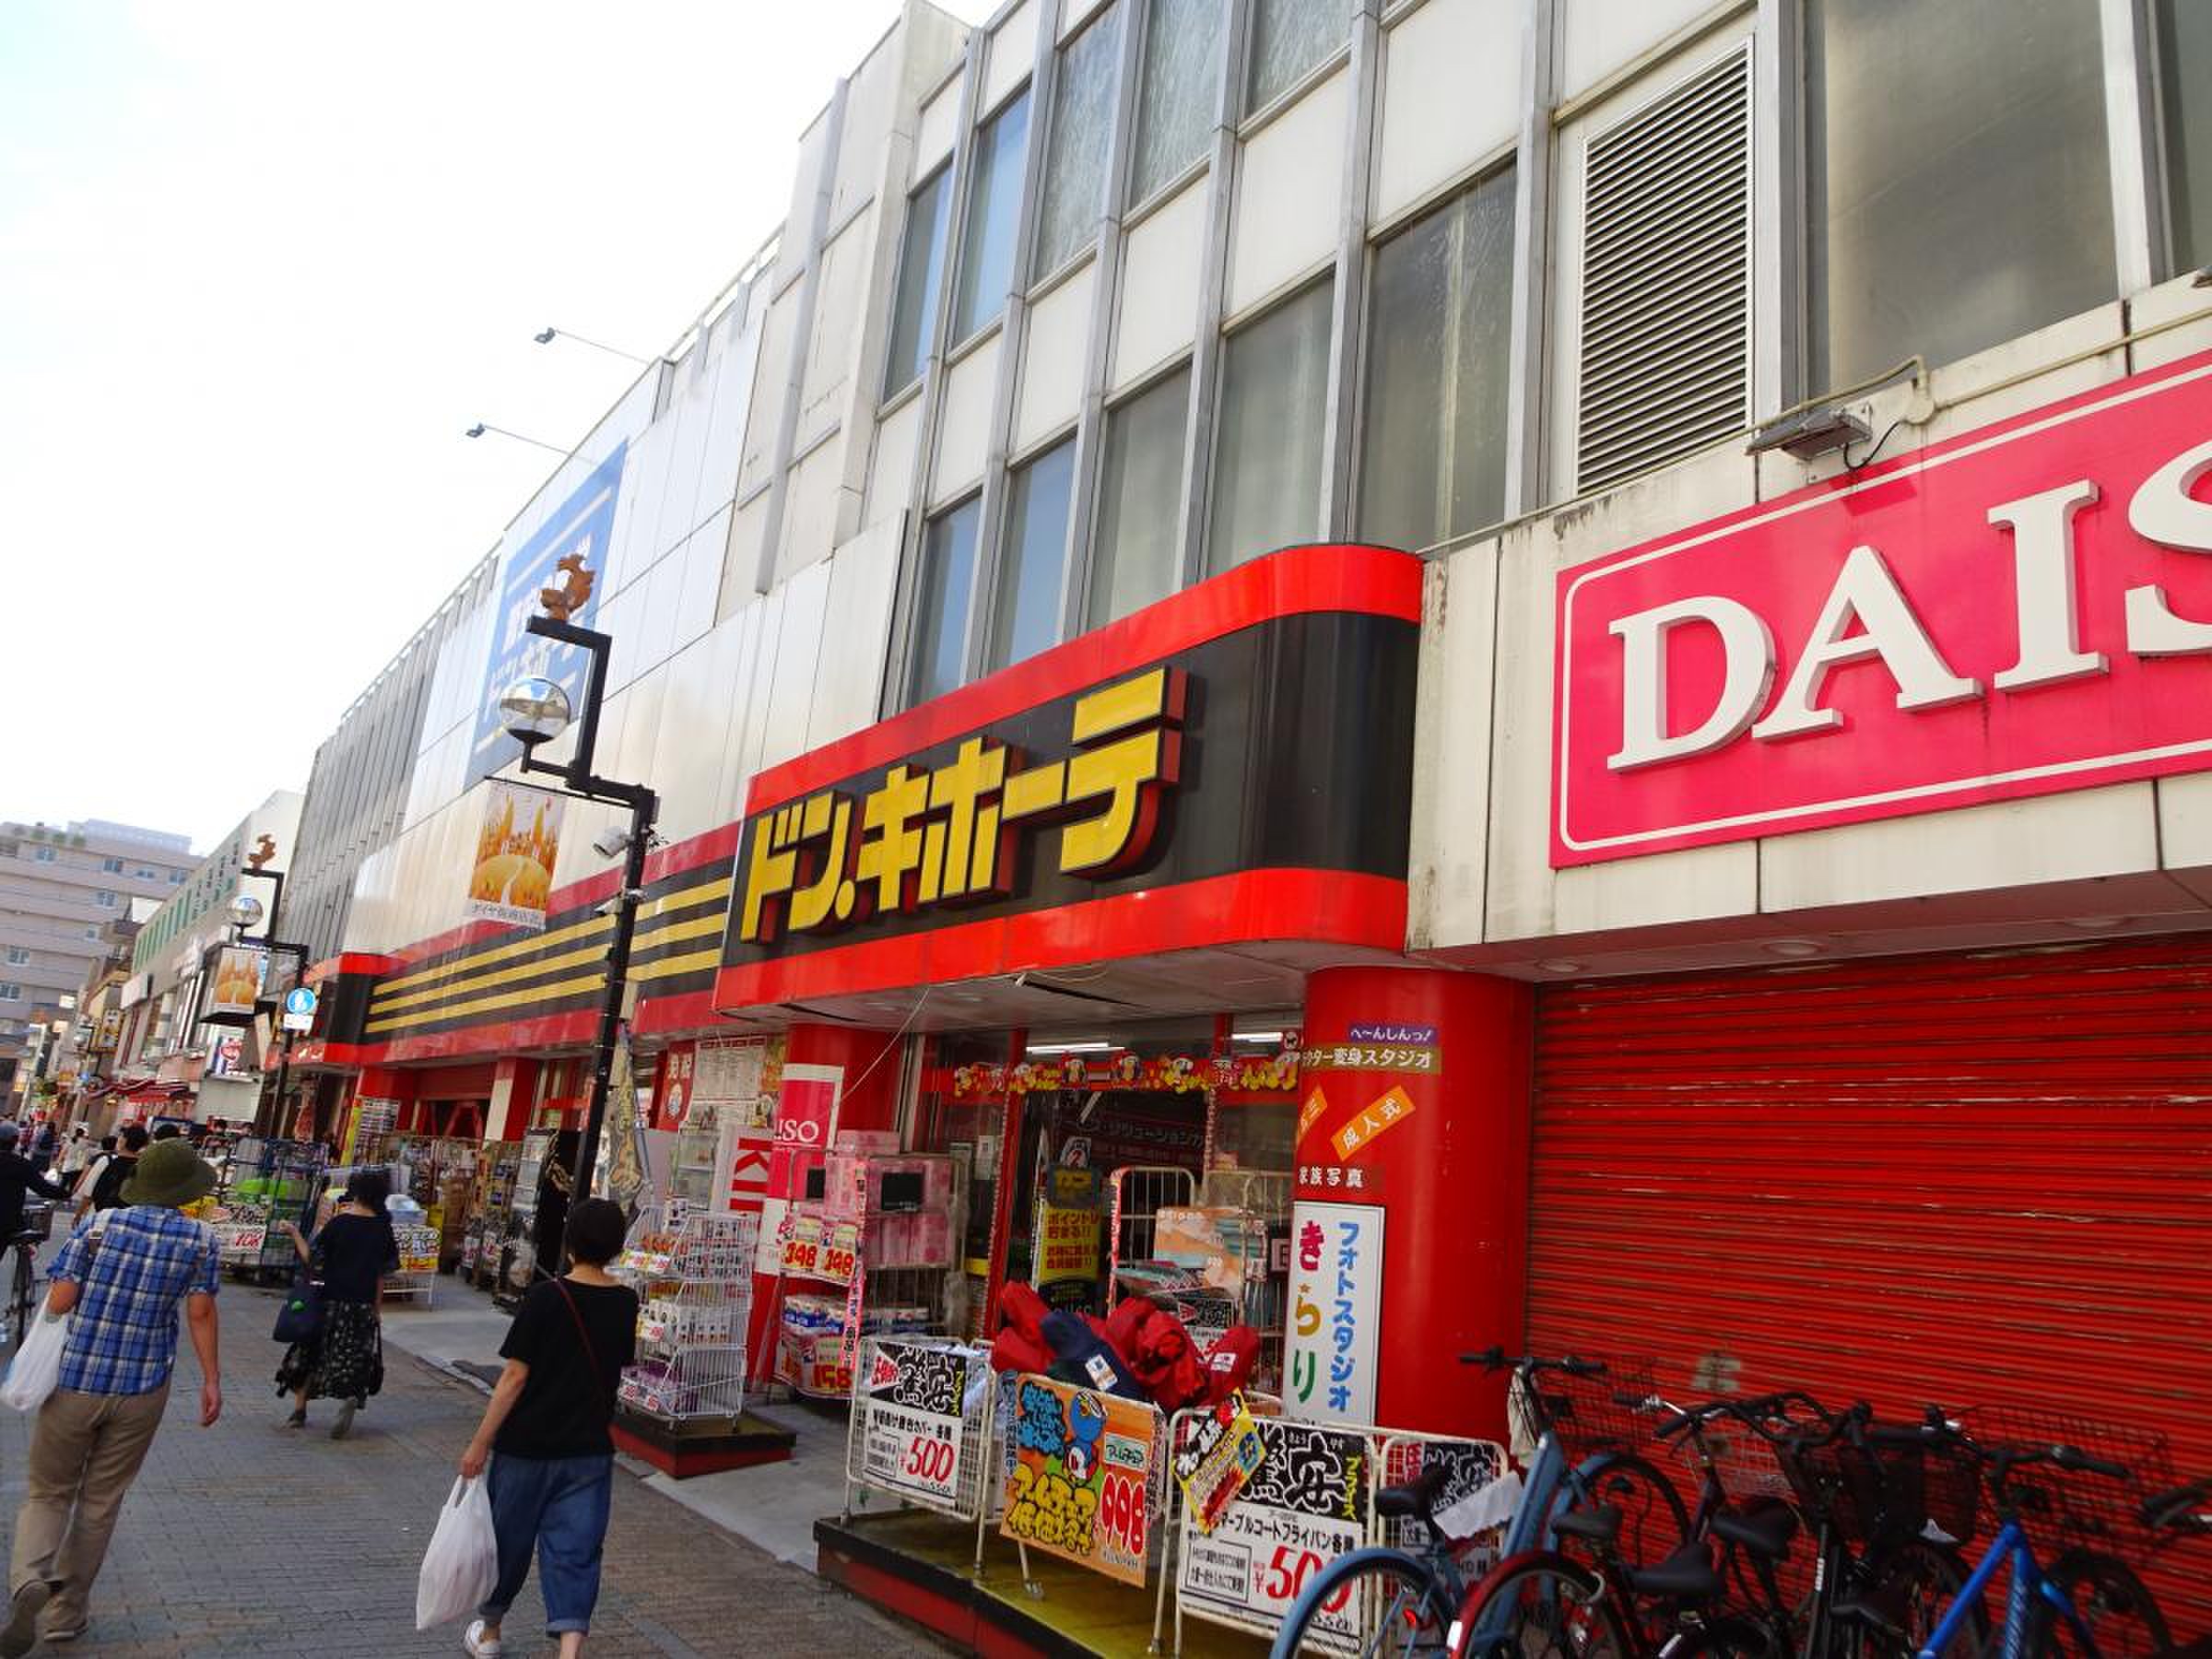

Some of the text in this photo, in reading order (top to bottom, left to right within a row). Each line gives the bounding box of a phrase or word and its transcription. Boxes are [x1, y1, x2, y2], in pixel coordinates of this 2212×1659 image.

[1607, 439, 2212, 772] DAIS
[1328, 1221, 1359, 1412] フォトスタジオ
[1100, 1473, 1147, 1556] 998
